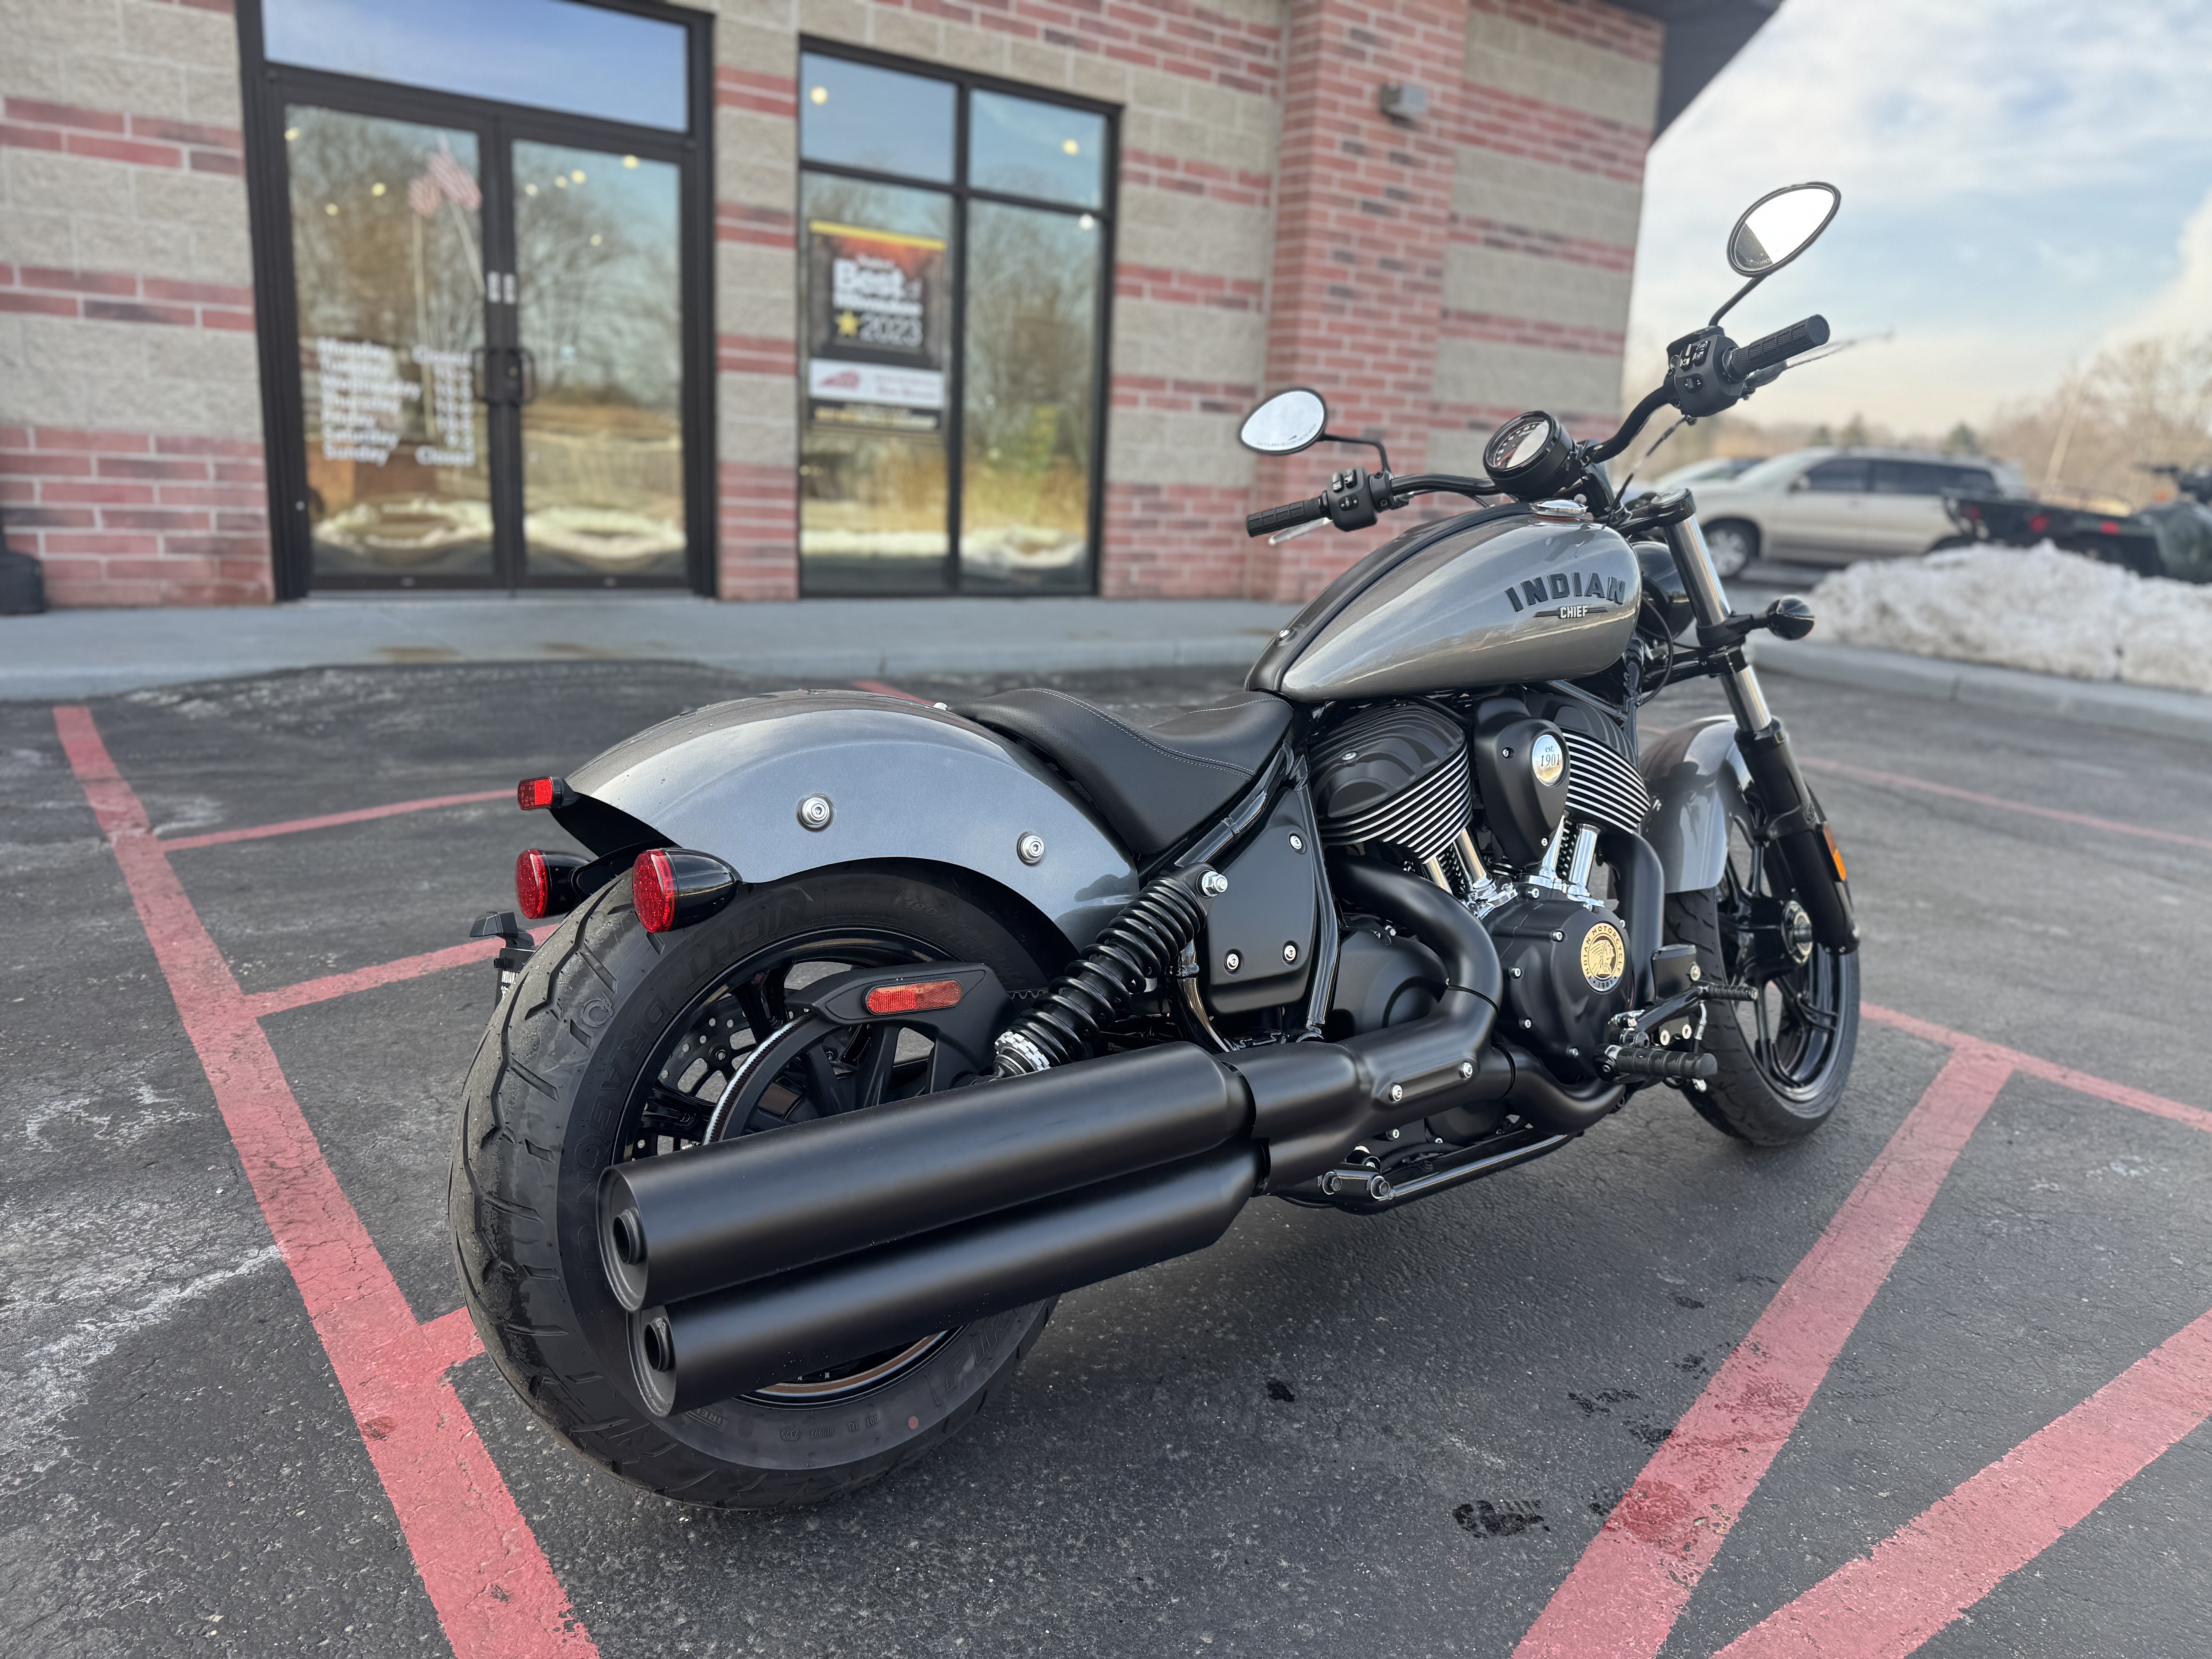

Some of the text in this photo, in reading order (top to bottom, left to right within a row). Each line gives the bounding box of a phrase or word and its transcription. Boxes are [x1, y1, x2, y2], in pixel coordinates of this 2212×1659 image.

[859, 313, 923, 347] 2023
[323, 444, 474, 467] Sunday Closed
[1505, 572, 1626, 612] INDIAN
[1560, 605, 1588, 618] CHIEF
[1540, 754, 1560, 767] 1901
[1583, 926, 1623, 979] INDIAN MOTORCYCLE
[1598, 980, 1613, 988] 1901
[867, 1414, 879, 1427] DOT
[781, 1429, 799, 1438] 2323
